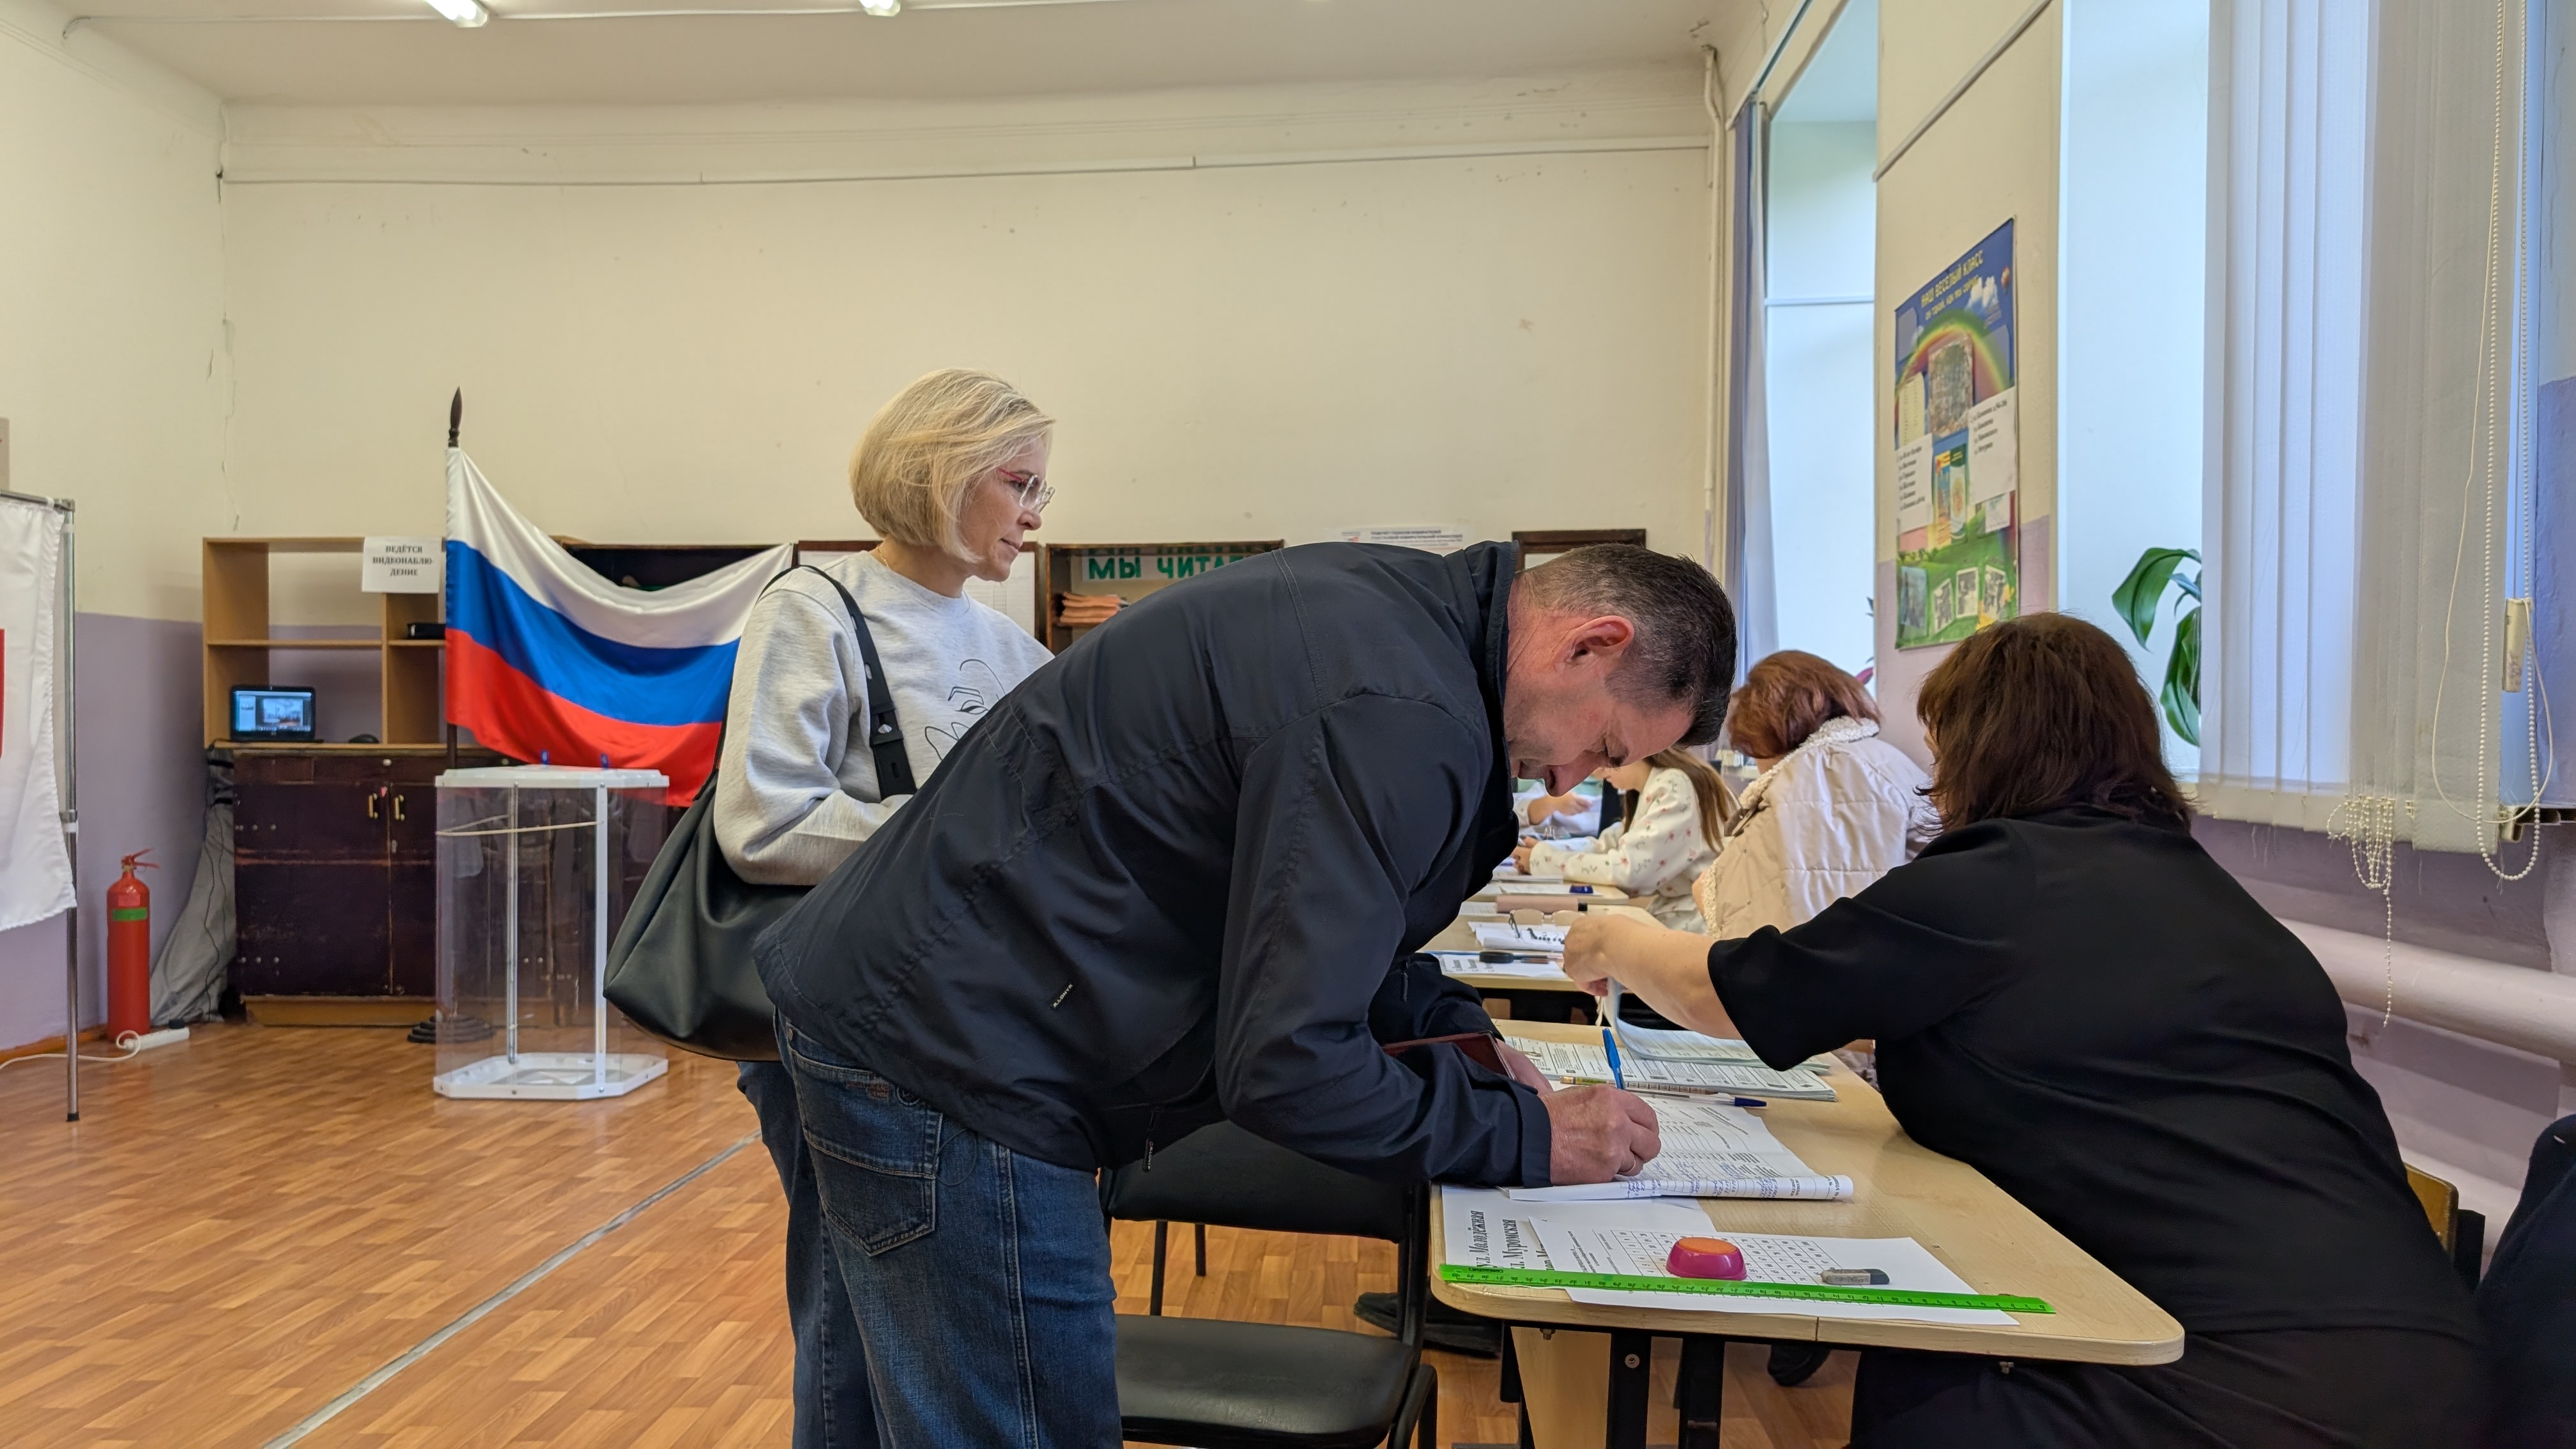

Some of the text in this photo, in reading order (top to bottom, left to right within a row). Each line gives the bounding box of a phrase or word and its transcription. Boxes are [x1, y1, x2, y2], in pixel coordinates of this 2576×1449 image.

[386, 545, 422, 553] ВЕДЁТСЯ
[1089, 557, 1142, 579] МЫ
[1468, 1210, 1490, 1255] Молодёжная
[1502, 1219, 1528, 1259] Муромская
